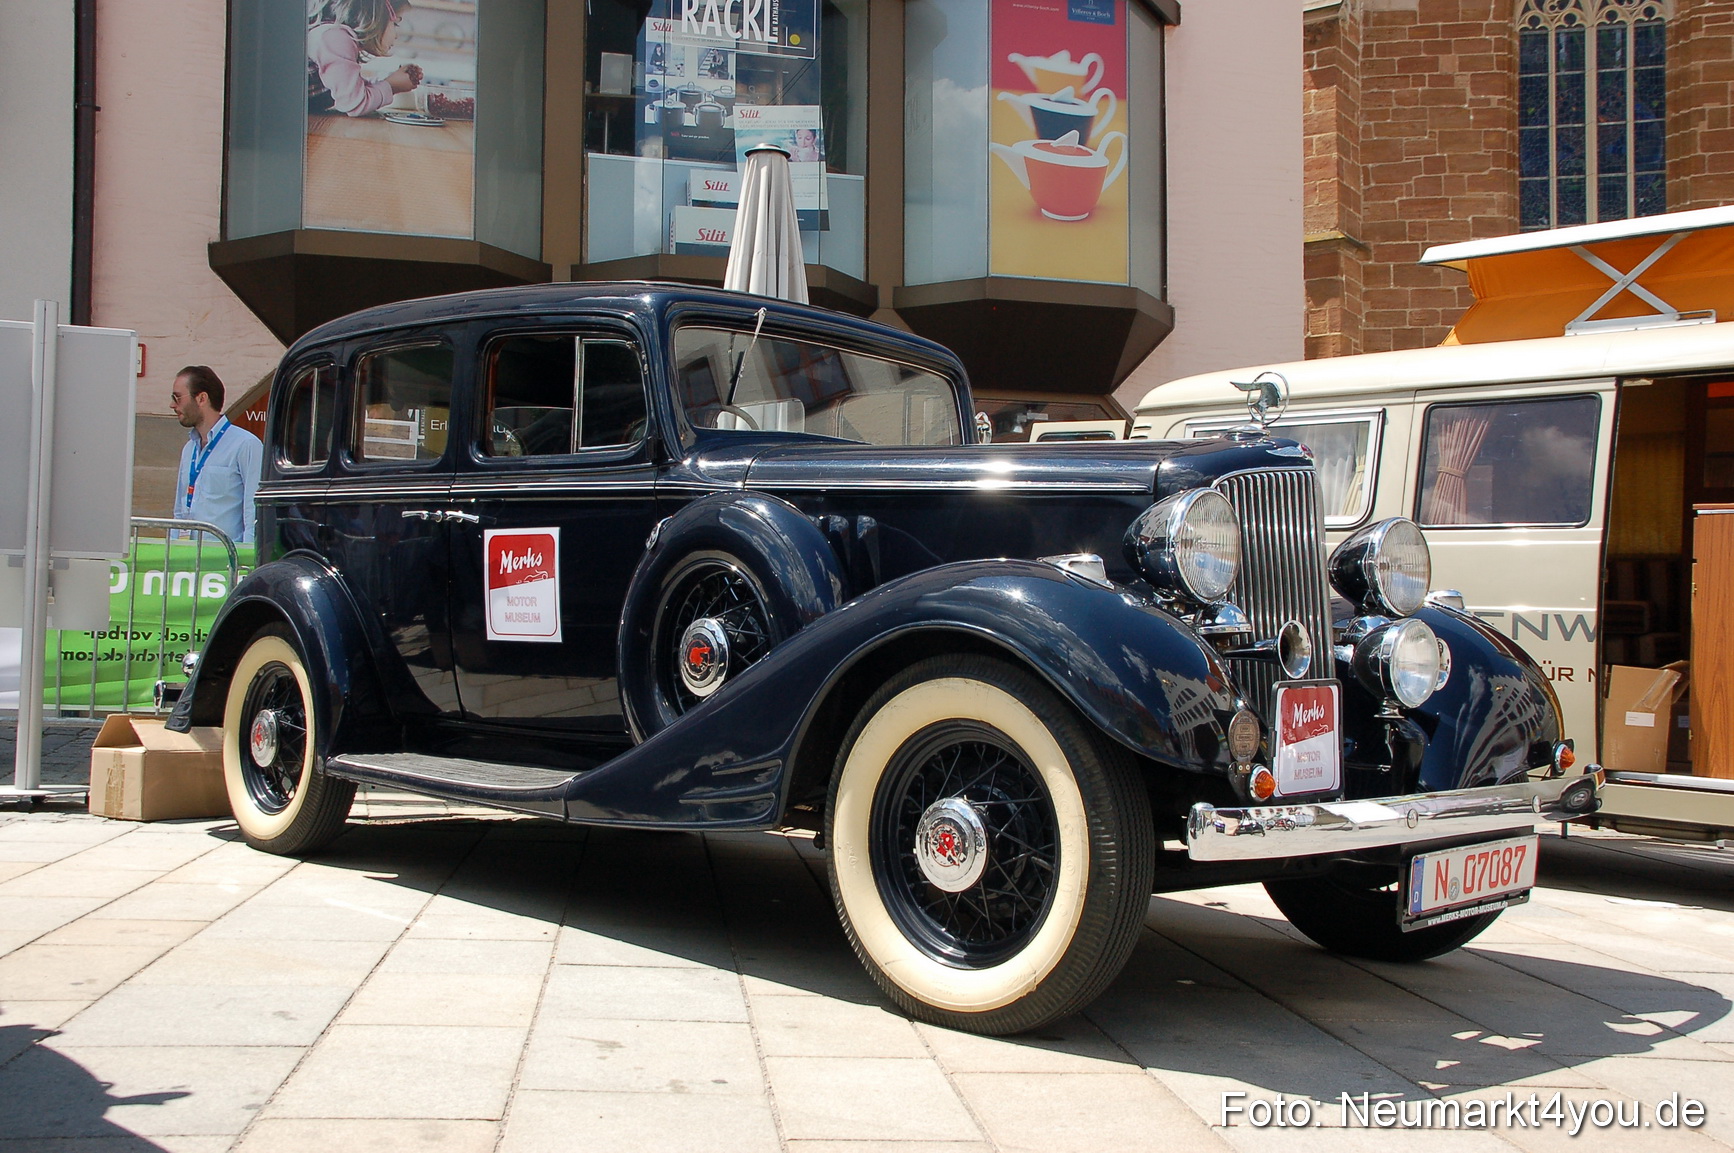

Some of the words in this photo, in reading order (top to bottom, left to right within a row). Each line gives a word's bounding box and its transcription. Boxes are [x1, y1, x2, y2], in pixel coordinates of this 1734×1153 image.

[1071, 7, 1091, 16] Villeroy
[1097, 10, 1111, 18] Boch
[681, 0, 778, 42] RACKL
[738, 109, 761, 119] Silit
[703, 180, 730, 192] Silit
[695, 228, 728, 243] Silit
[499, 547, 543, 575] Merks
[506, 596, 538, 608] MOTOR
[504, 612, 542, 624] MUSEUM
[1291, 699, 1325, 729] Merks
[1296, 750, 1321, 764] MOTOR
[1293, 766, 1323, 781] MUSEUM
[1434, 858, 1450, 902] N
[1462, 845, 1527, 895] 07087
[1413, 891, 1419, 904] D
